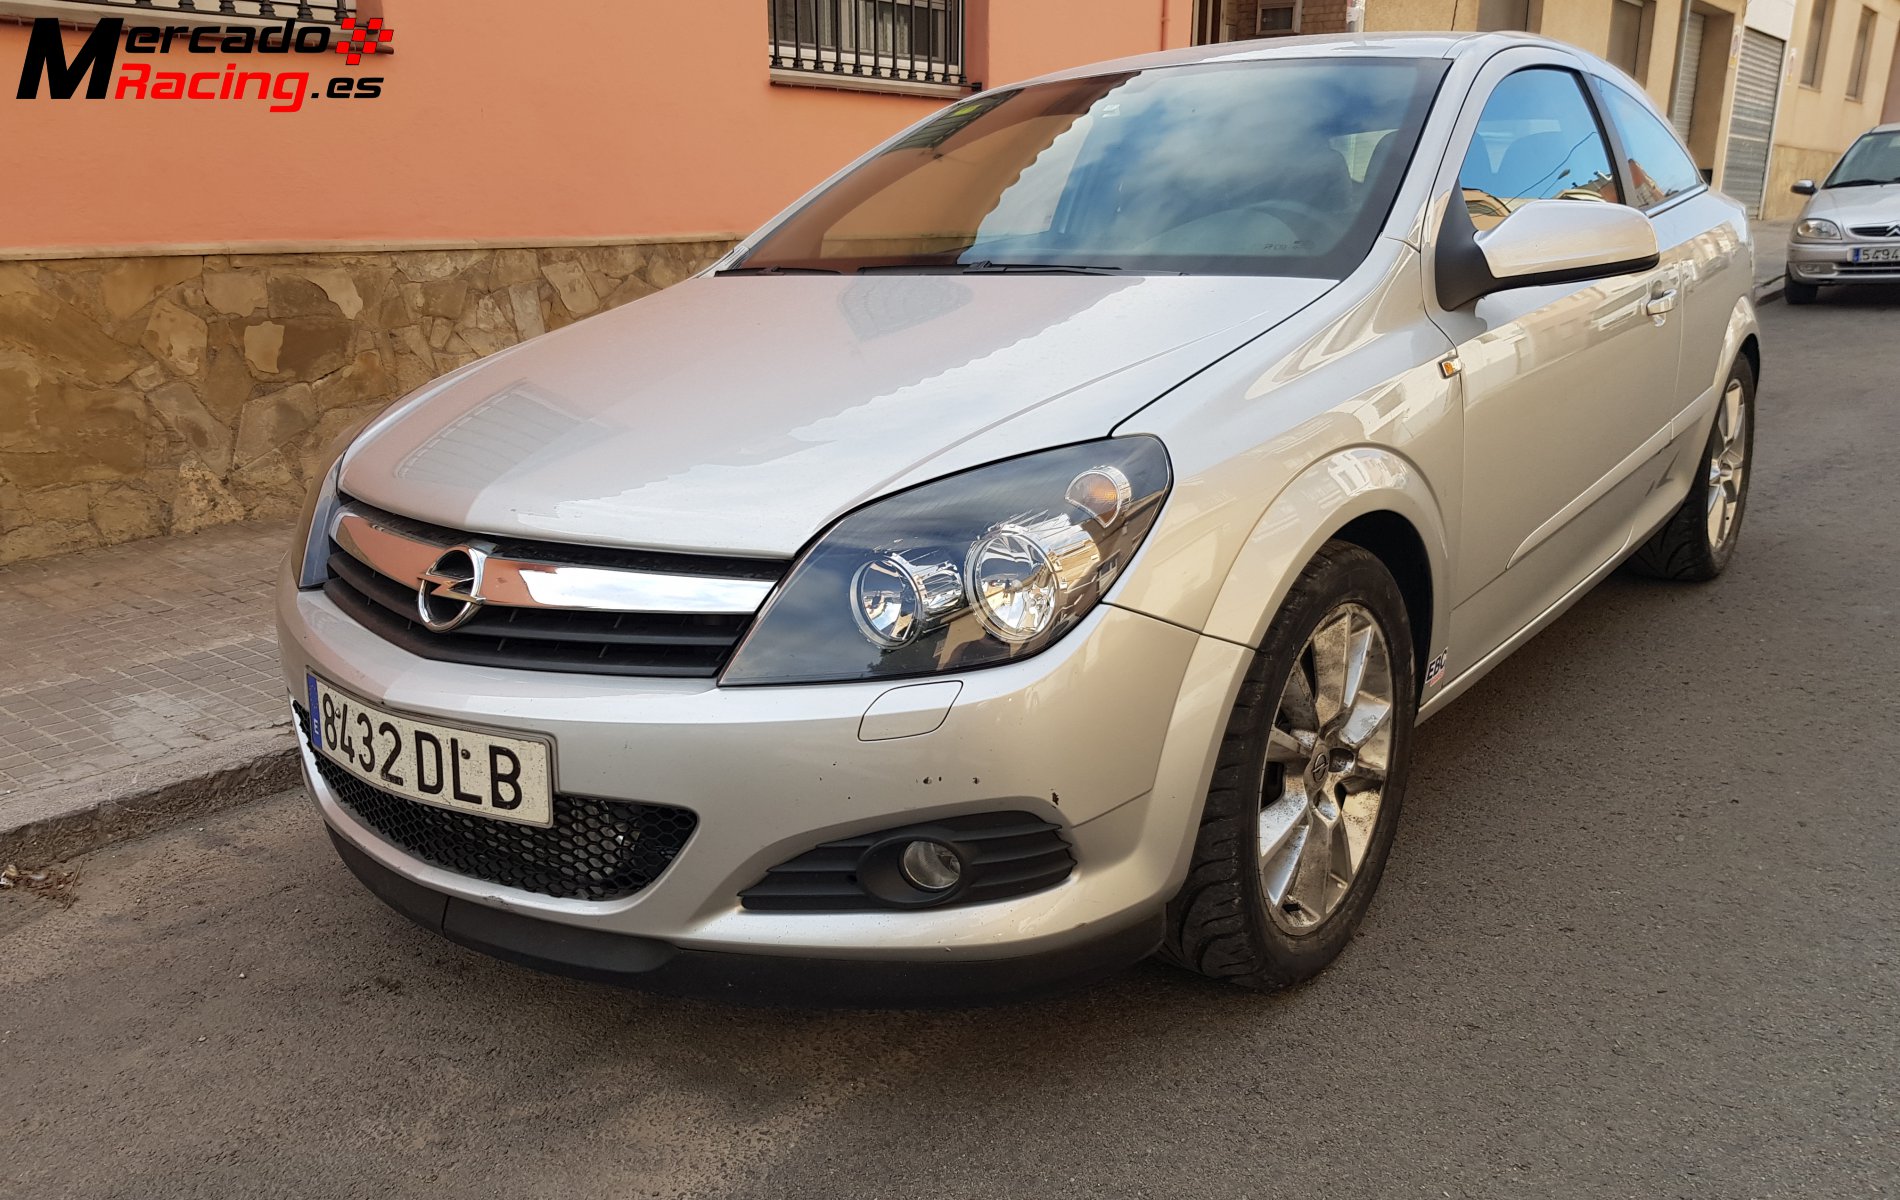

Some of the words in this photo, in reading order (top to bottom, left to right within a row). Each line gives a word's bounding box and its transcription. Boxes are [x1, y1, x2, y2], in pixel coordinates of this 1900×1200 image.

[313, 718, 320, 735] E
[322, 693, 404, 786] 8432
[414, 729, 523, 810] DLB
